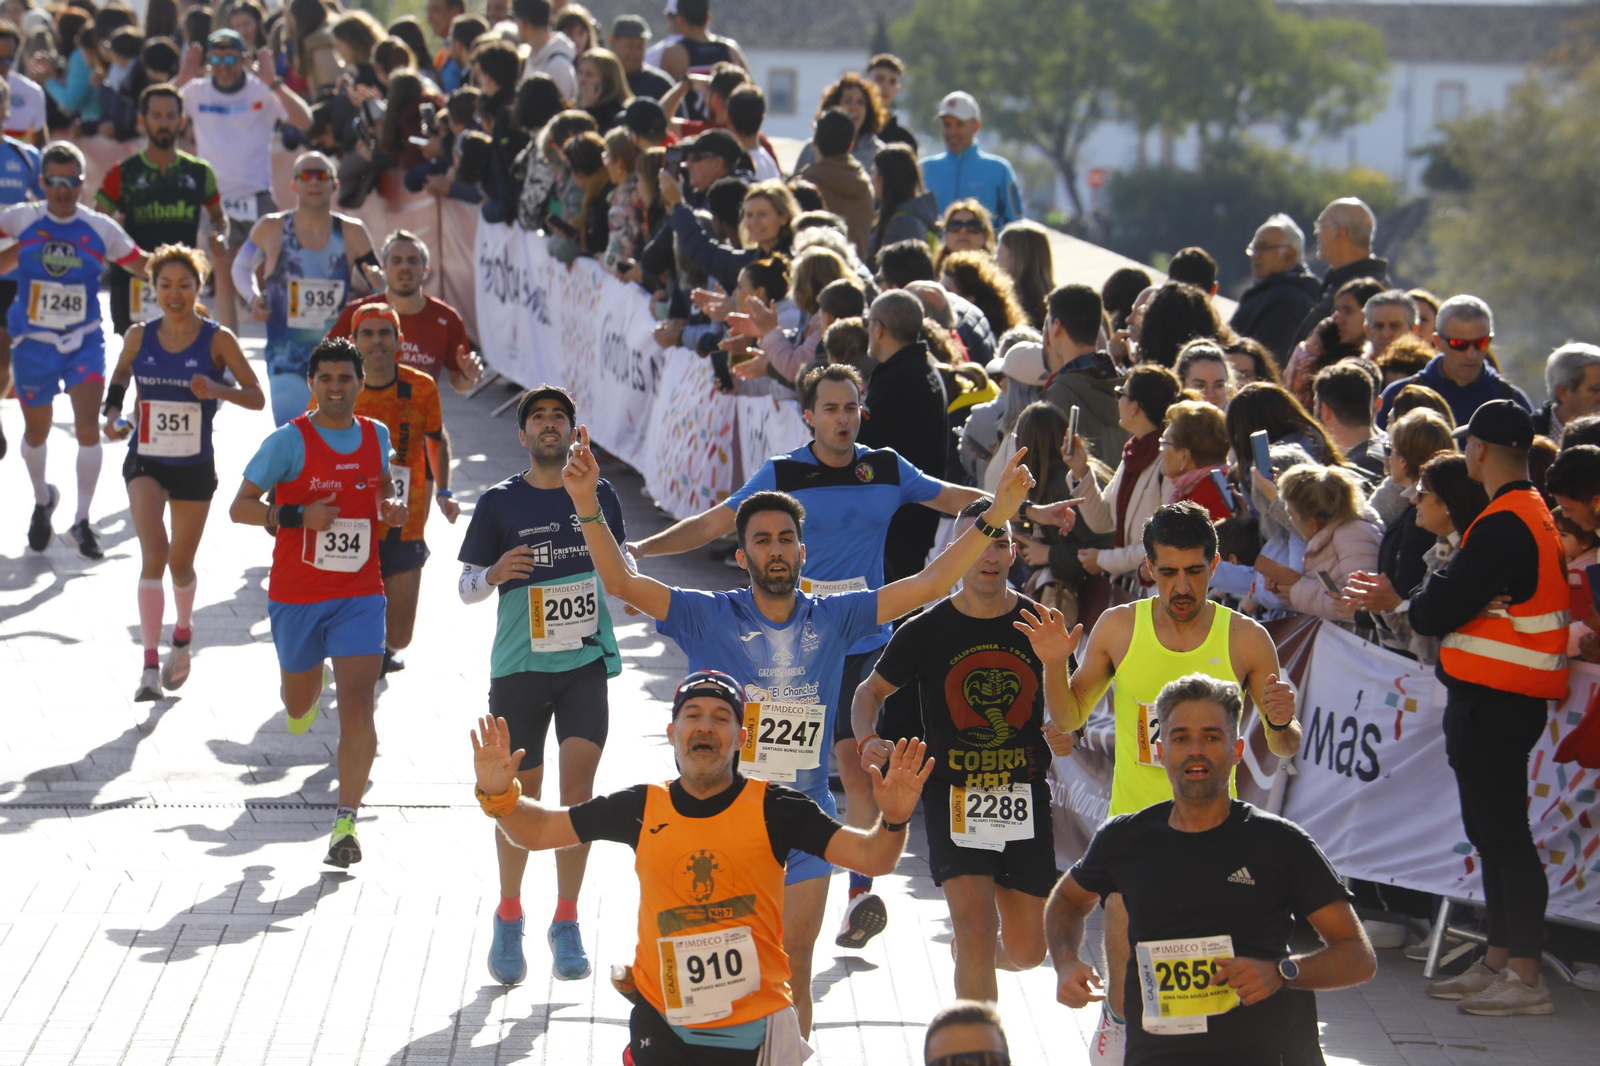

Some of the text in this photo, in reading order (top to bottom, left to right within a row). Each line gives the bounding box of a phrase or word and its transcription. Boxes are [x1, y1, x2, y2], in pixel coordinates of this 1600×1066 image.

[41, 294, 82, 311] 1248
[305, 290, 335, 307] 935
[157, 414, 189, 431] 351
[395, 479, 404, 497] 3
[569, 514, 581, 527] 3
[324, 532, 361, 553] 334
[553, 545, 589, 555] CRISTALER
[552, 584, 580, 594] IMDECO
[545, 592, 596, 621] 2035
[950, 643, 999, 665] CALIFORNIA
[1009, 646, 1032, 664] 1984
[772, 705, 804, 714] IMDECO
[758, 718, 820, 747] 2247
[1149, 718, 1160, 744] 2
[1303, 690, 1382, 782] Más
[948, 748, 1027, 771] COBRA
[967, 794, 1028, 821] 2288
[1228, 876, 1255, 886] adidas
[684, 936, 722, 949] IMDECO
[1161, 943, 1199, 954] IMDECO
[686, 949, 743, 984] 910
[727, 977, 746, 985] ROMERO
